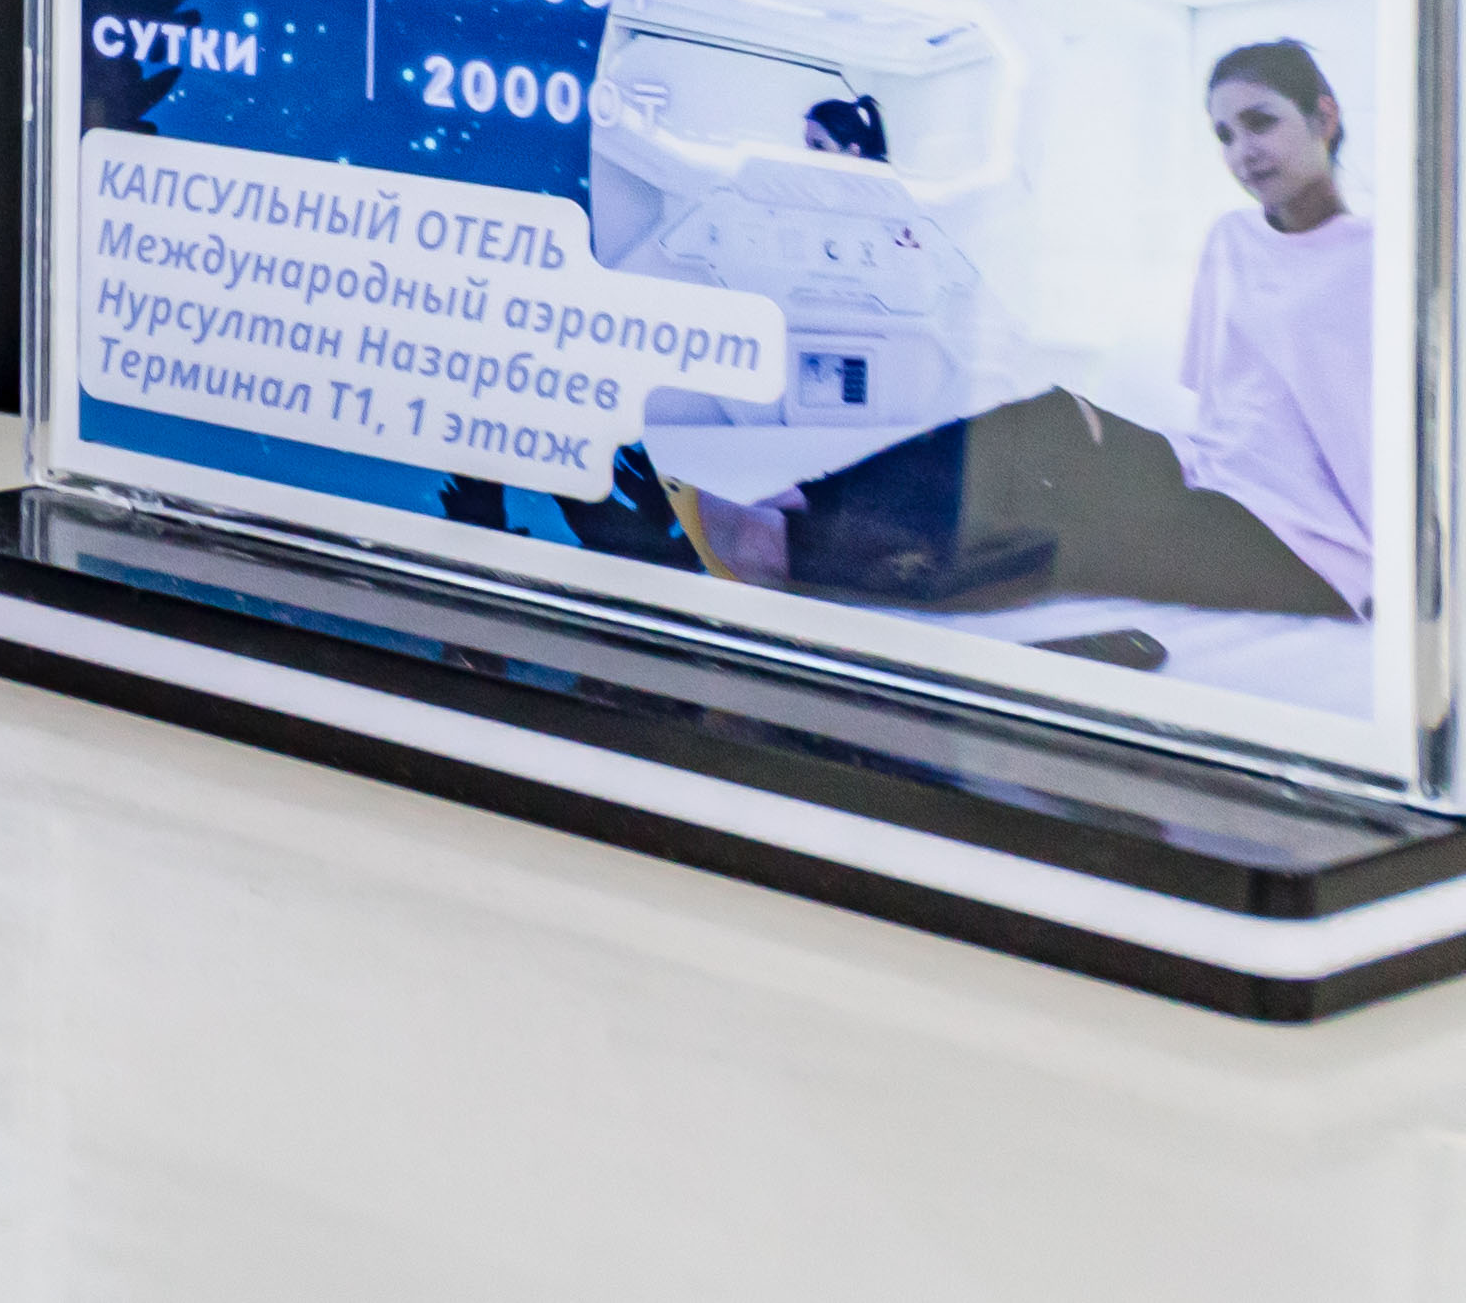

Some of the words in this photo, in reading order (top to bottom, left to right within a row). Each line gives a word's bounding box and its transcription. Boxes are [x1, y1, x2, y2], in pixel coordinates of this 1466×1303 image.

[92, 15, 258, 77] СУТКИ
[100, 160, 400, 244] КАПСУЛЬНЫЙ
[416, 209, 566, 270] ОТЕЛЬ
[98, 220, 490, 322] Международный
[504, 292, 763, 372] аэропорт
[98, 280, 343, 358] Нурсултан
[359, 326, 620, 411] Назарбаев
[100, 336, 313, 413] Терминал
[329, 380, 386, 435] Т1,
[407, 398, 424, 437] 1
[442, 421, 593, 470] этаж
